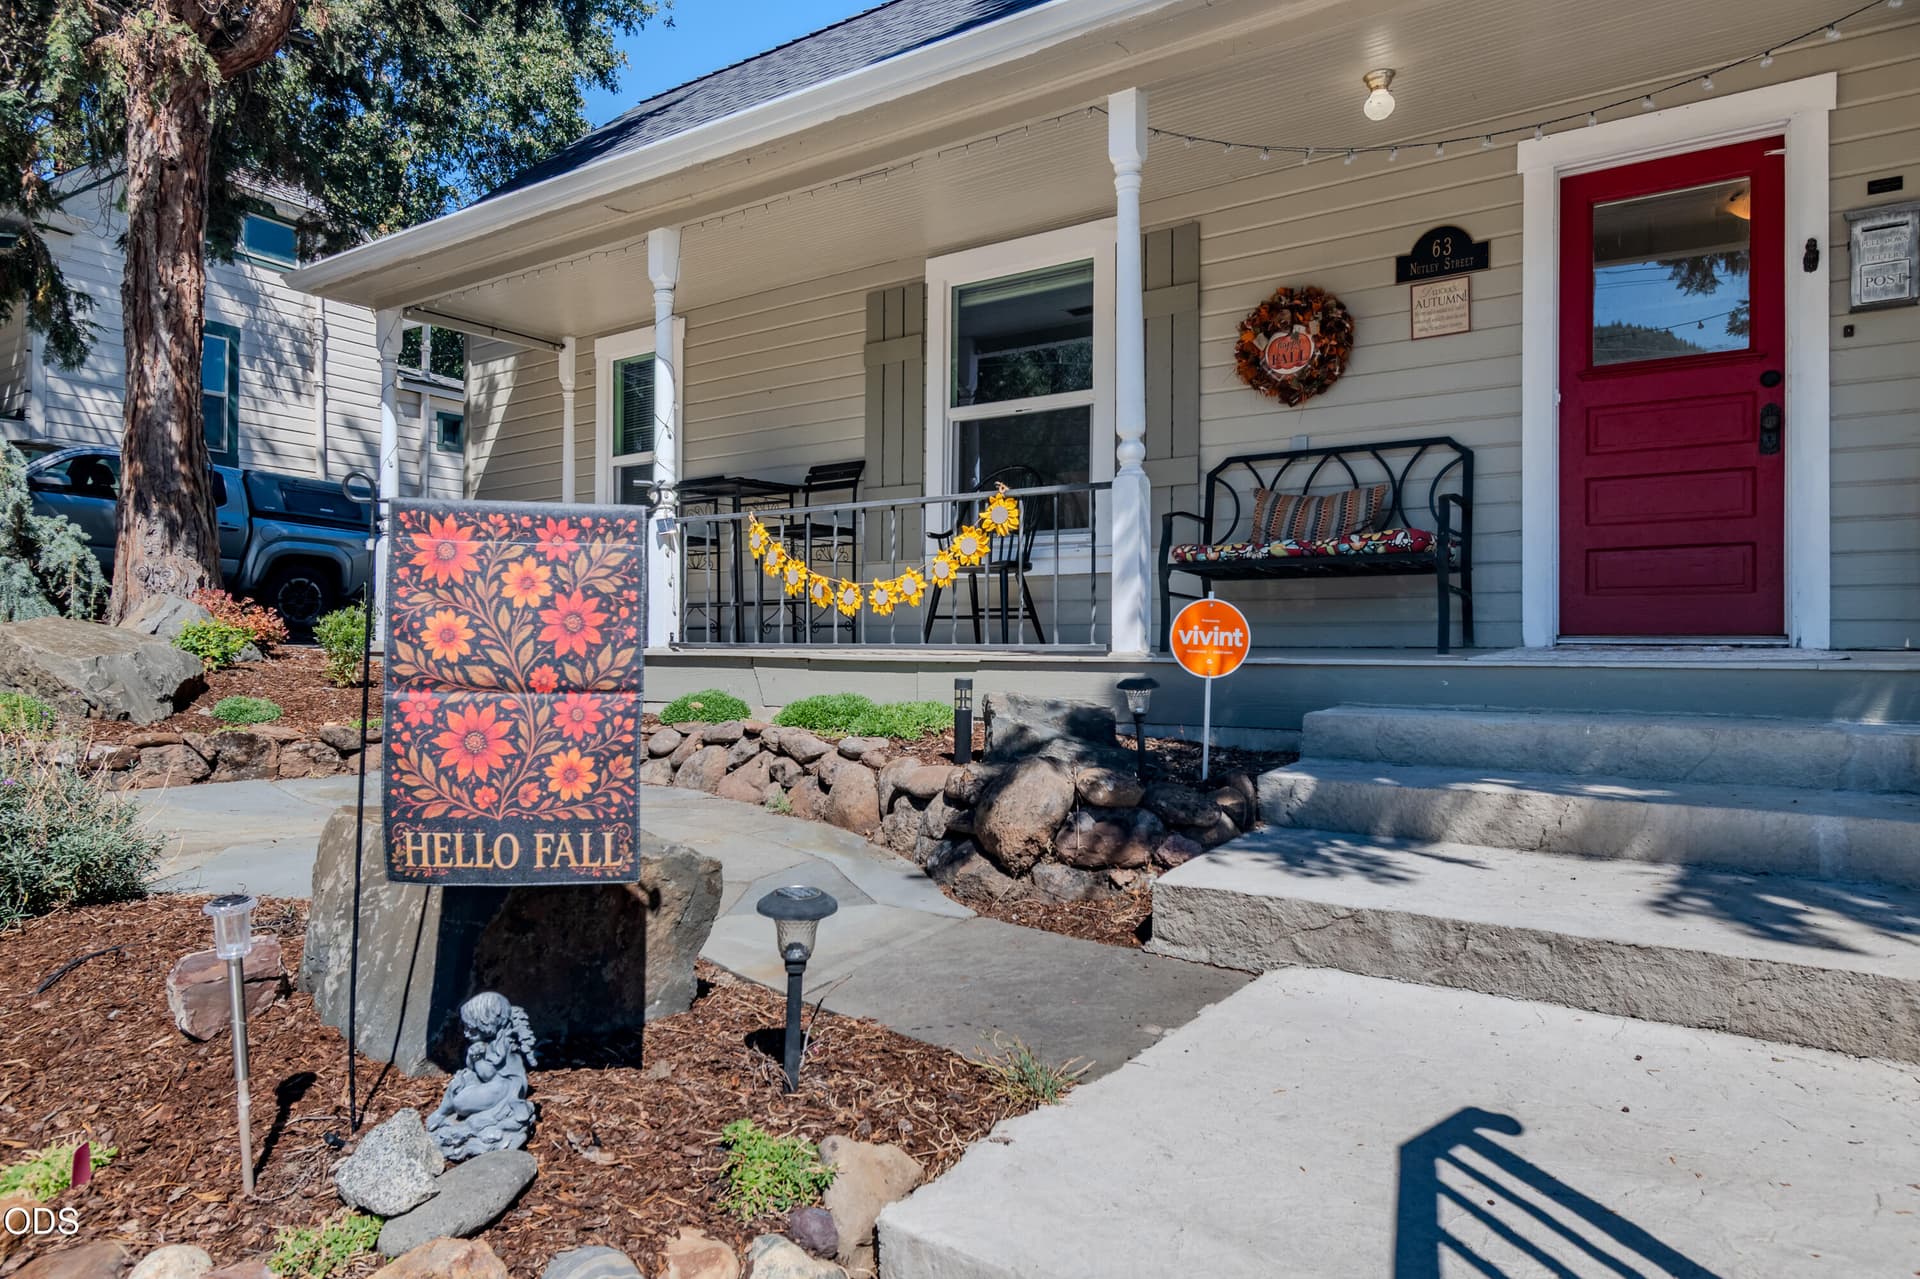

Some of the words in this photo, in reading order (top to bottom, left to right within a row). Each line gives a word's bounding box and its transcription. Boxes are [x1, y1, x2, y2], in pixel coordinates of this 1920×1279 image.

[1432, 236, 1452, 258] 63
[1443, 256, 1475, 270] STREET
[1864, 272, 1906, 288] POST
[1415, 289, 1468, 310] AUTUMN!
[1271, 350, 1307, 366] FALL
[1178, 625, 1244, 648] vivint
[404, 831, 521, 870] HELLO
[533, 831, 624, 869] FALL
